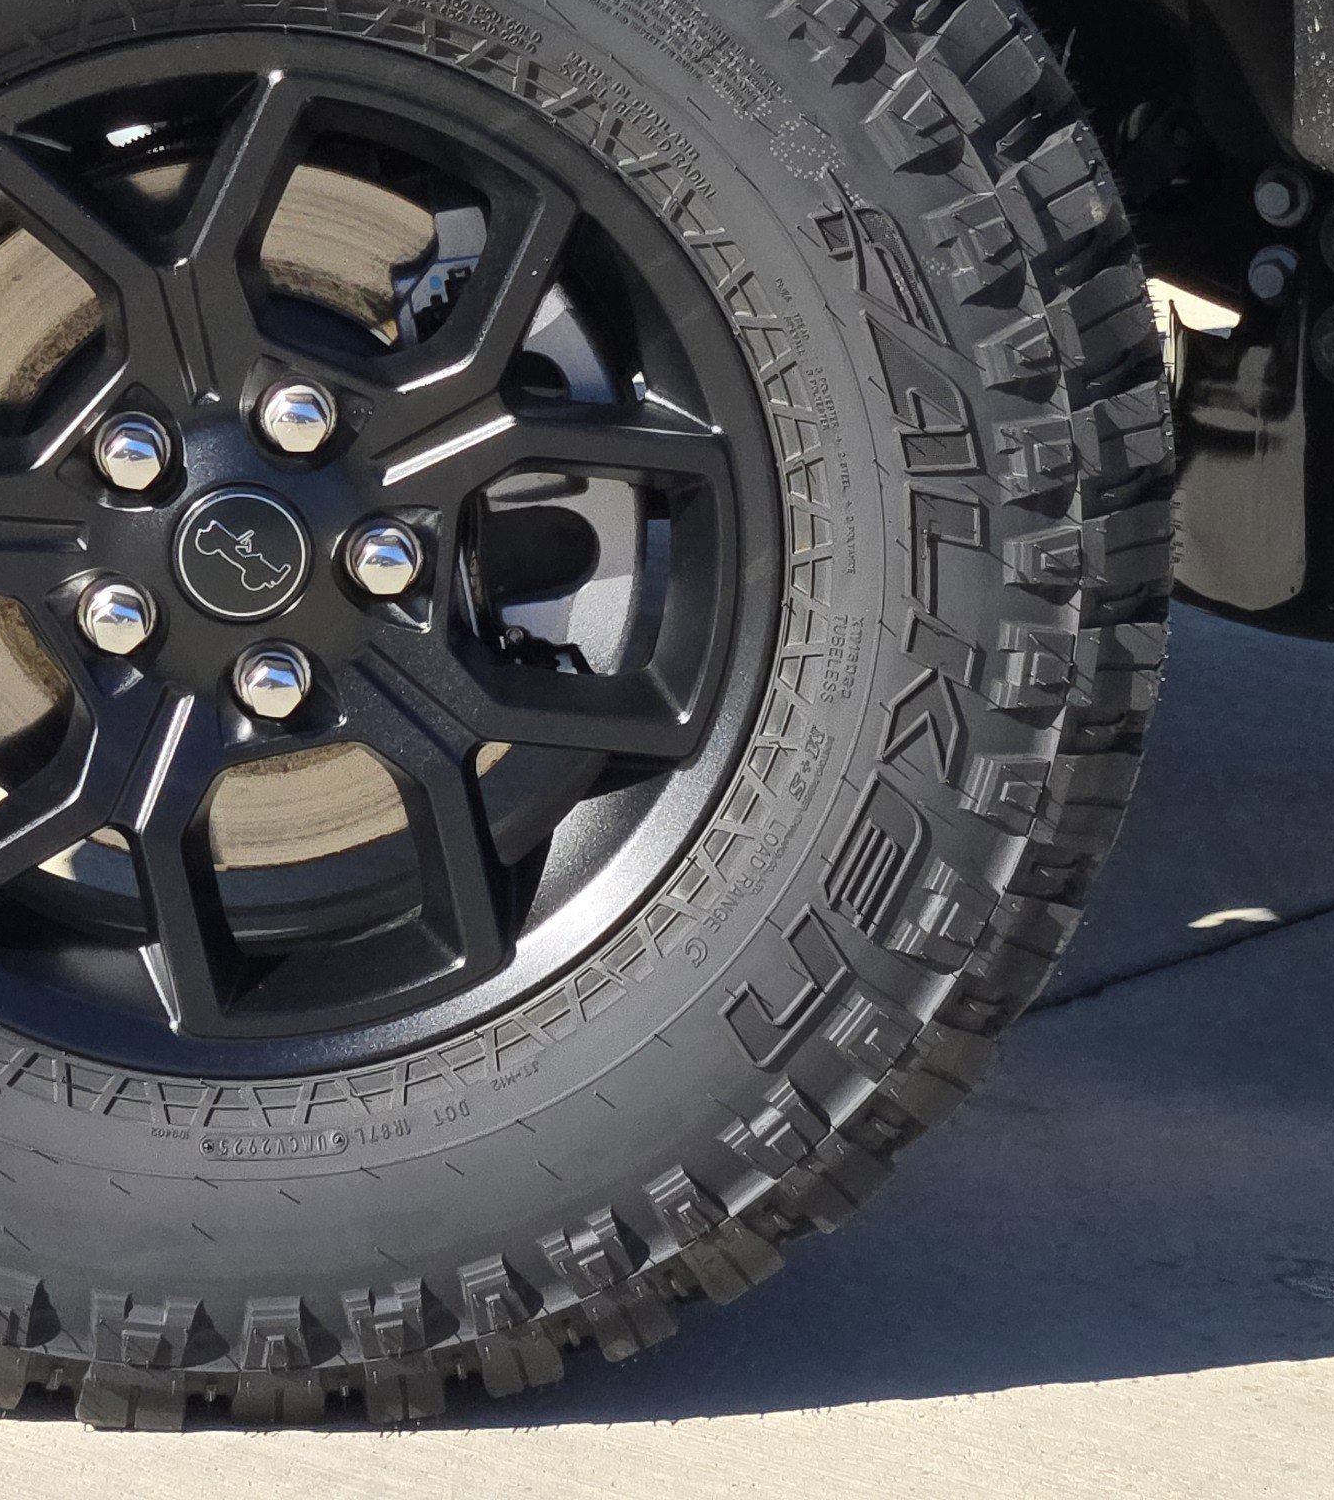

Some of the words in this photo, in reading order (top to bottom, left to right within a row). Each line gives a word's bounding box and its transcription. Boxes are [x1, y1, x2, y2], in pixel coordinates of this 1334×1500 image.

[819, 614, 850, 706] TUBELESS
[749, 818, 787, 873] LOAD
[701, 875, 756, 934] RANGE
[682, 933, 710, 969] C
[428, 1097, 472, 1128] DOT
